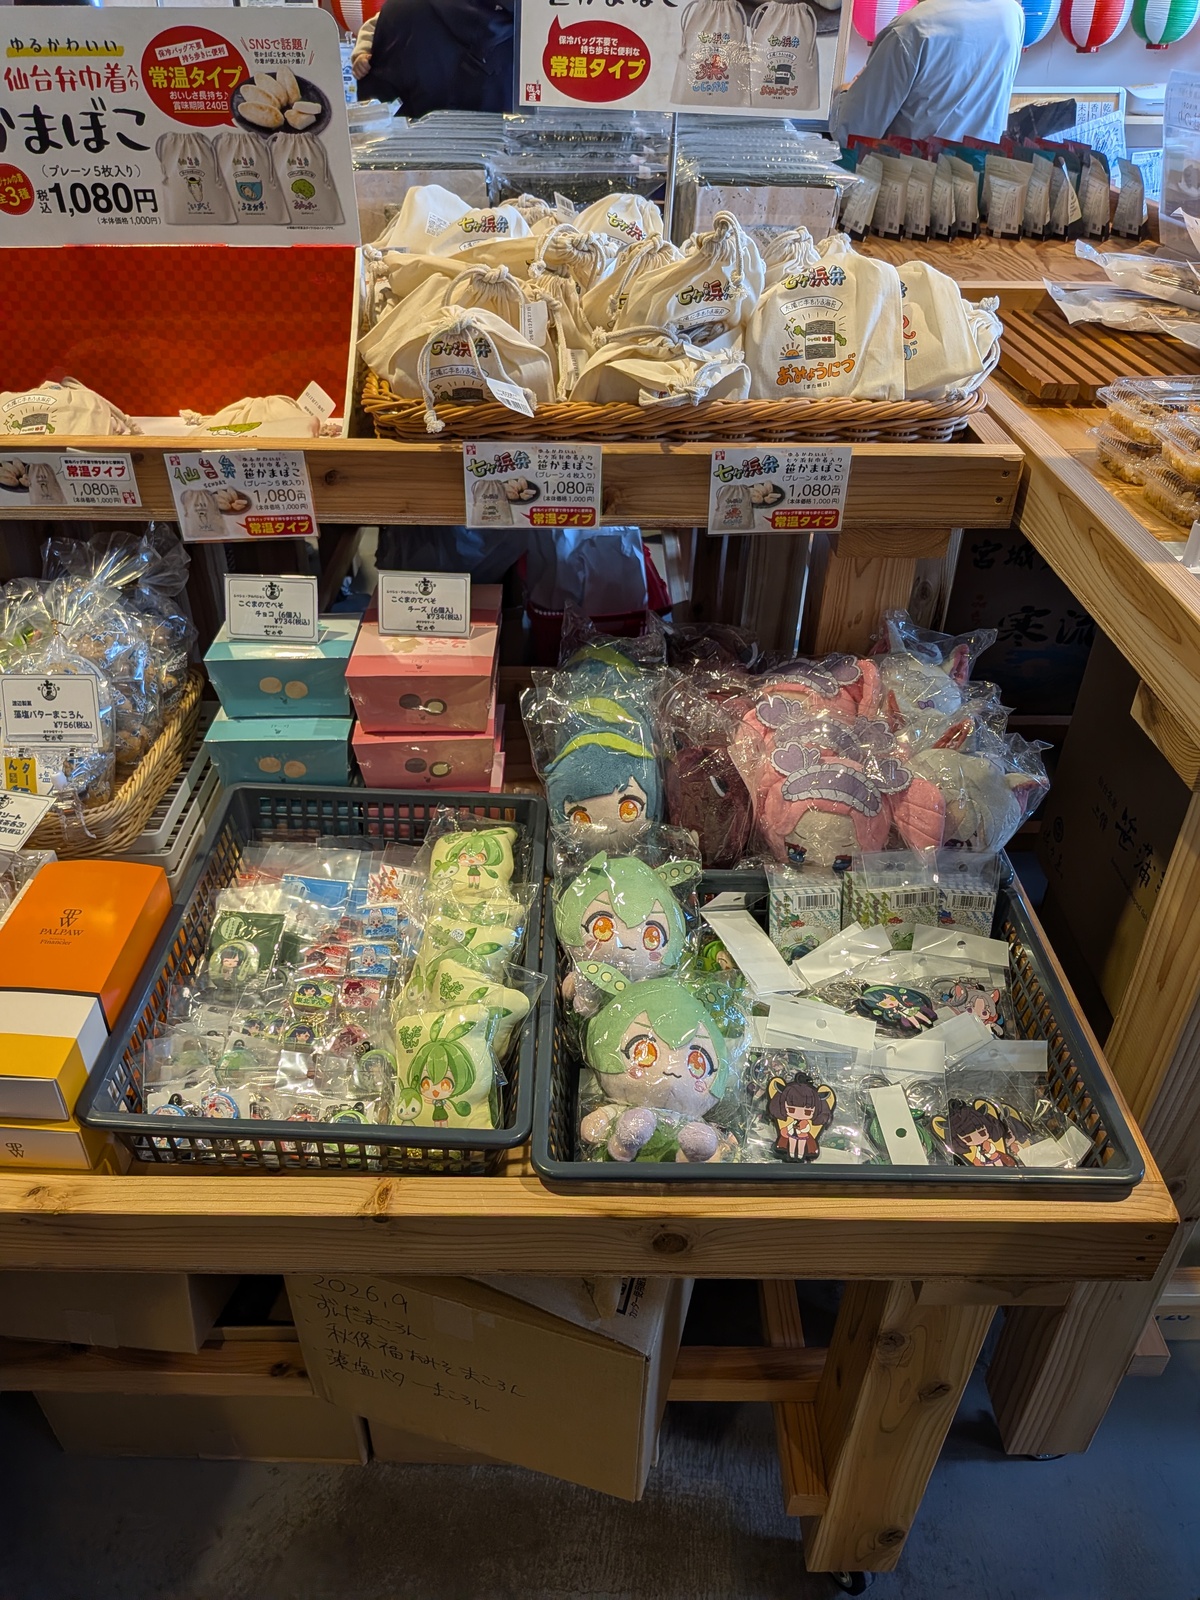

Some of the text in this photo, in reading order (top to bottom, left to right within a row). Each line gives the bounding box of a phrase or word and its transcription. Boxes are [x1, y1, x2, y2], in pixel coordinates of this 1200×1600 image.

[10, 37, 117, 53] ゆるかわいい
[559, 36, 619, 46] 保冷バッグ不要で
[157, 40, 203, 59] 保冷バッグ不要
[181, 46, 226, 64] 持ち歩きに便利
[580, 46, 640, 56] 持ち歩きに便利な
[550, 55, 646, 80] 常温タイプ
[4, 62, 127, 93] 仙台弁巾着
[148, 65, 243, 89] 常温タイプ
[36, 189, 52, 214] 税込
[48, 182, 159, 217] 1,080円
[458, 214, 509, 233] 七ヶ浜弁
[607, 212, 647, 241] 七ヶ浜
[781, 265, 846, 290] 七ヶ浜弁
[776, 353, 856, 386] おみょうにづ
[66, 465, 126, 477] 常温タイプ
[466, 450, 531, 477] 七ヶ浜弁
[713, 455, 780, 482] 七ヶ浜弁
[70, 483, 119, 496] 1,080円
[543, 481, 594, 494] 1,080円
[789, 484, 840, 497] 1,080円
[253, 489, 306, 503] 1,080円
[532, 513, 593, 524] 常温タイプ
[774, 515, 836, 527] 常温タイプ
[250, 521, 310, 534] 常温タイプ
[971, 539, 1050, 570] 宮城
[238, 600, 284, 609] こぐまのでべそ
[391, 596, 437, 604] こぐまのでべそ
[39, 928, 84, 936] PALPAW
